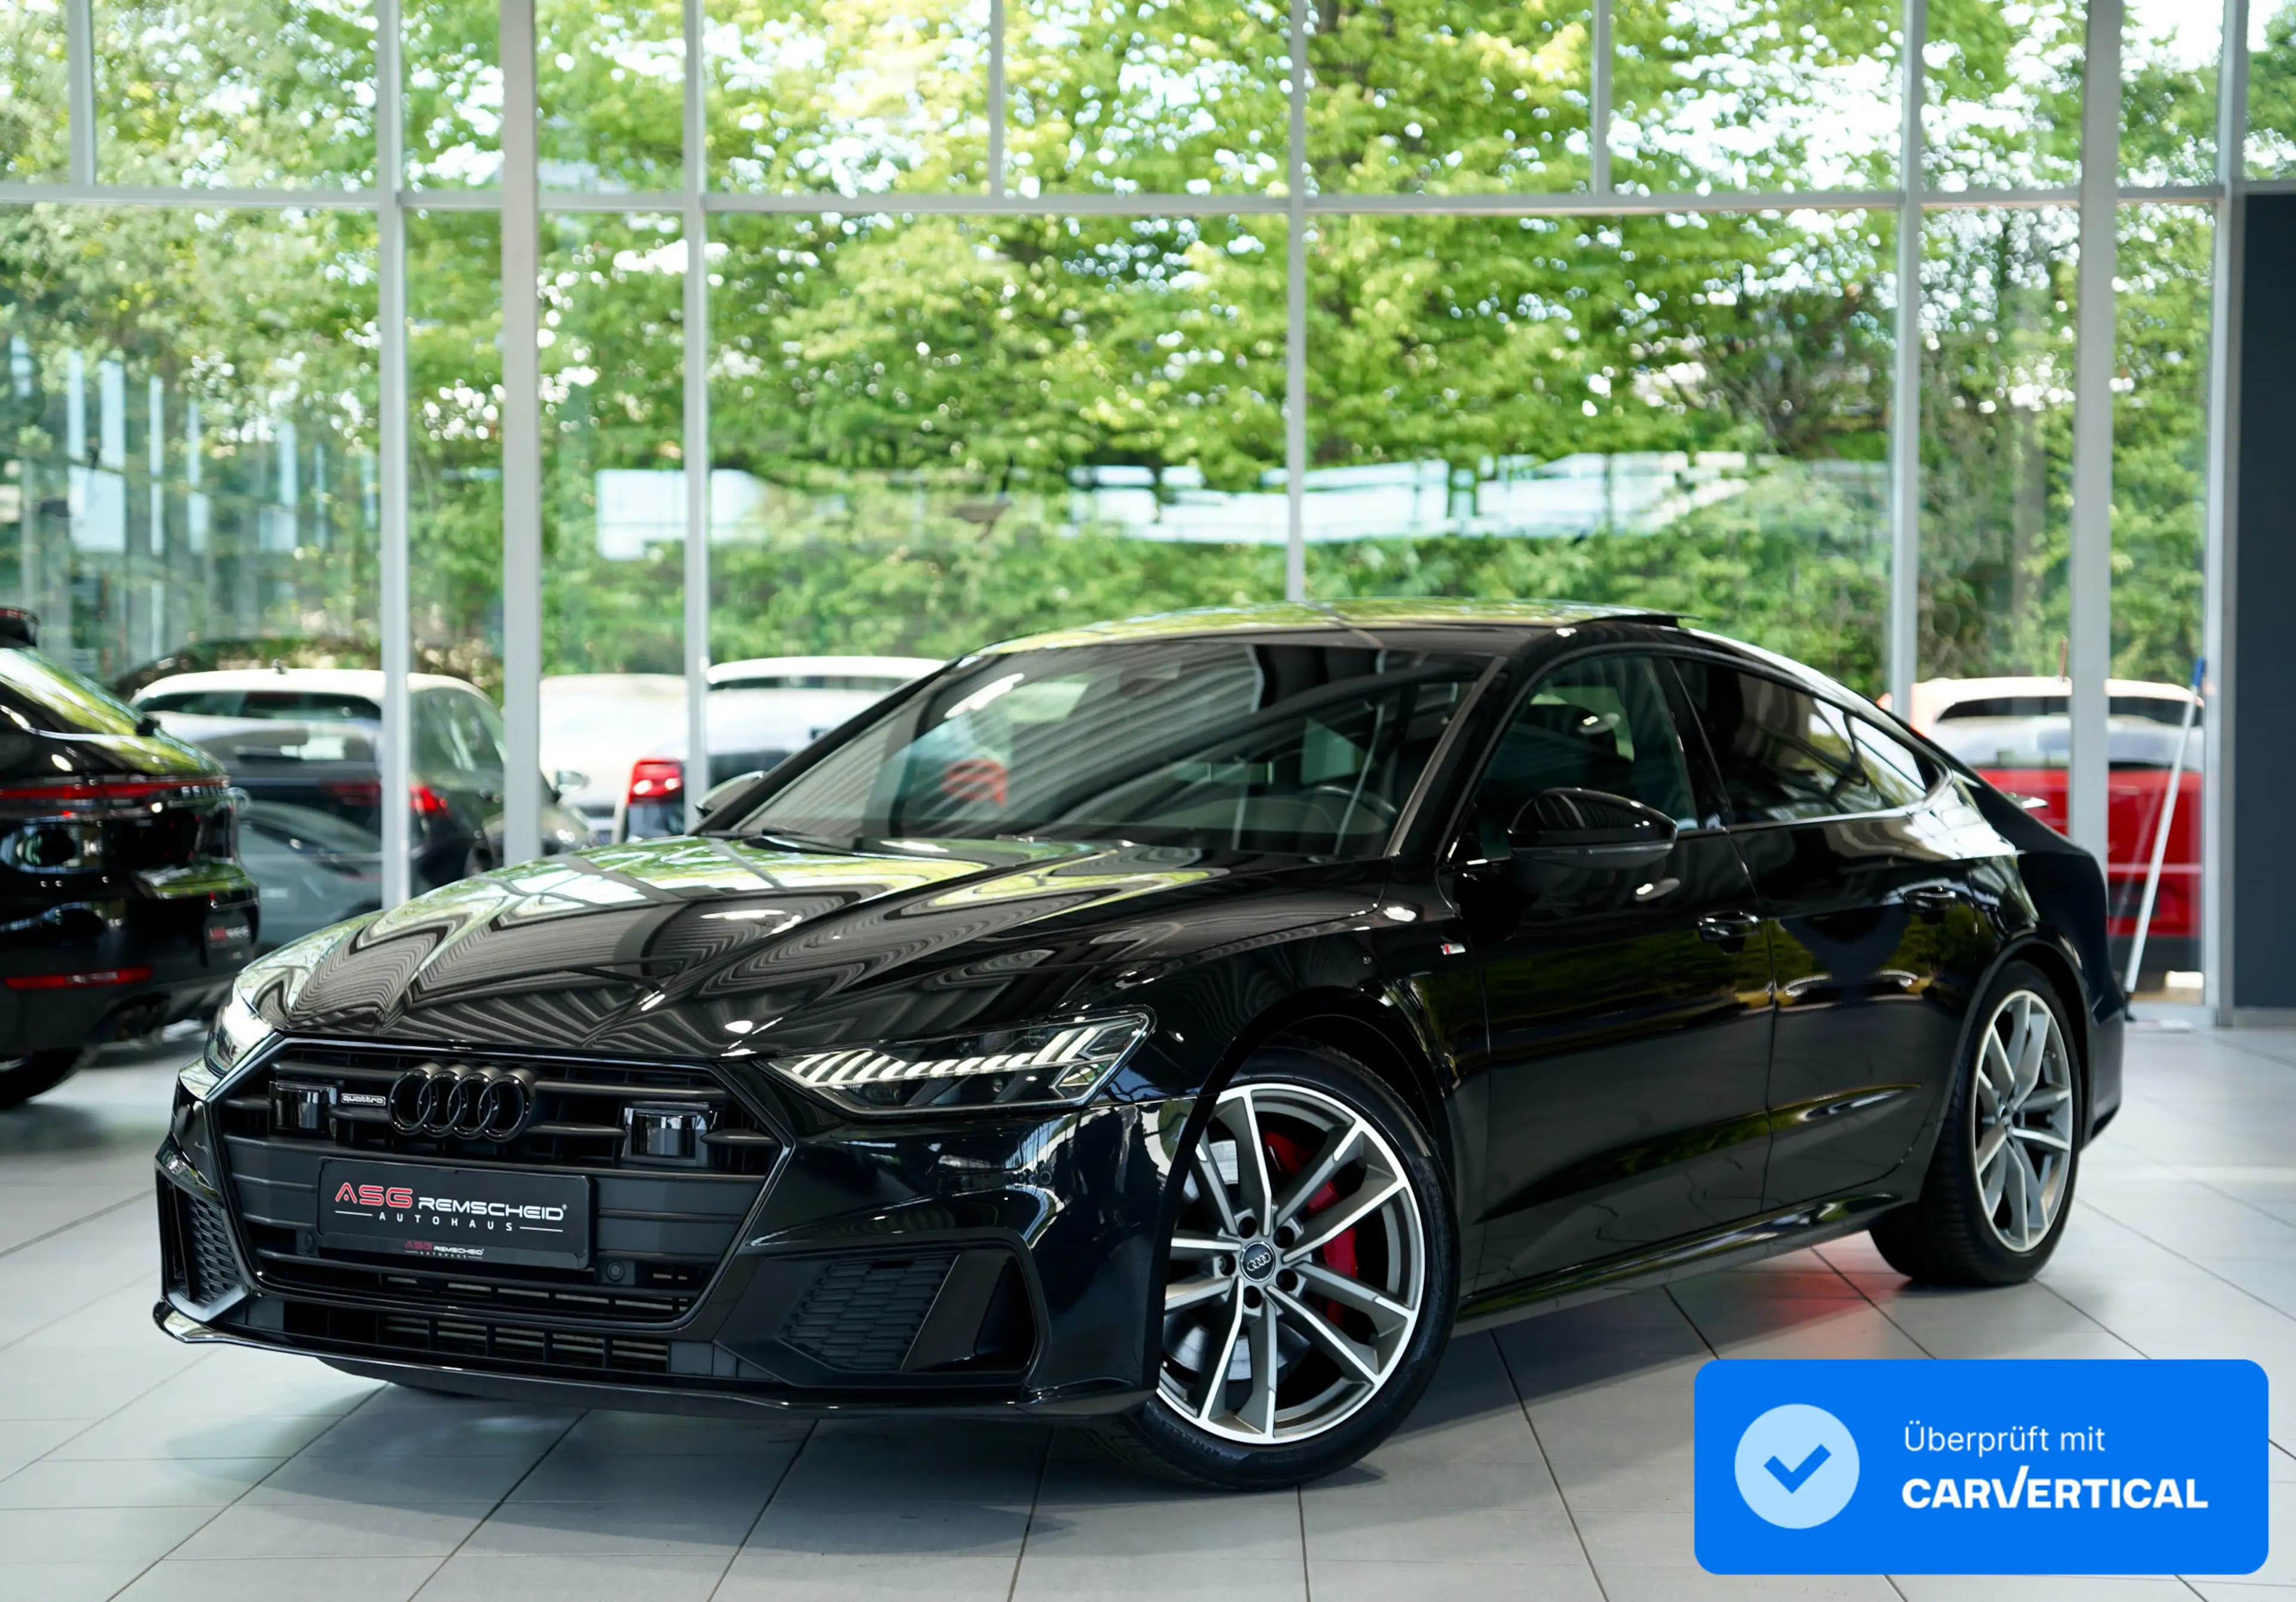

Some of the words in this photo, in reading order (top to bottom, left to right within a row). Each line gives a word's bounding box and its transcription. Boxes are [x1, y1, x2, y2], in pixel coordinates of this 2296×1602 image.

[342, 1095, 384, 1105] quattro
[334, 1182, 413, 1209] ASG
[378, 1211, 513, 1231] AUTOHAUS
